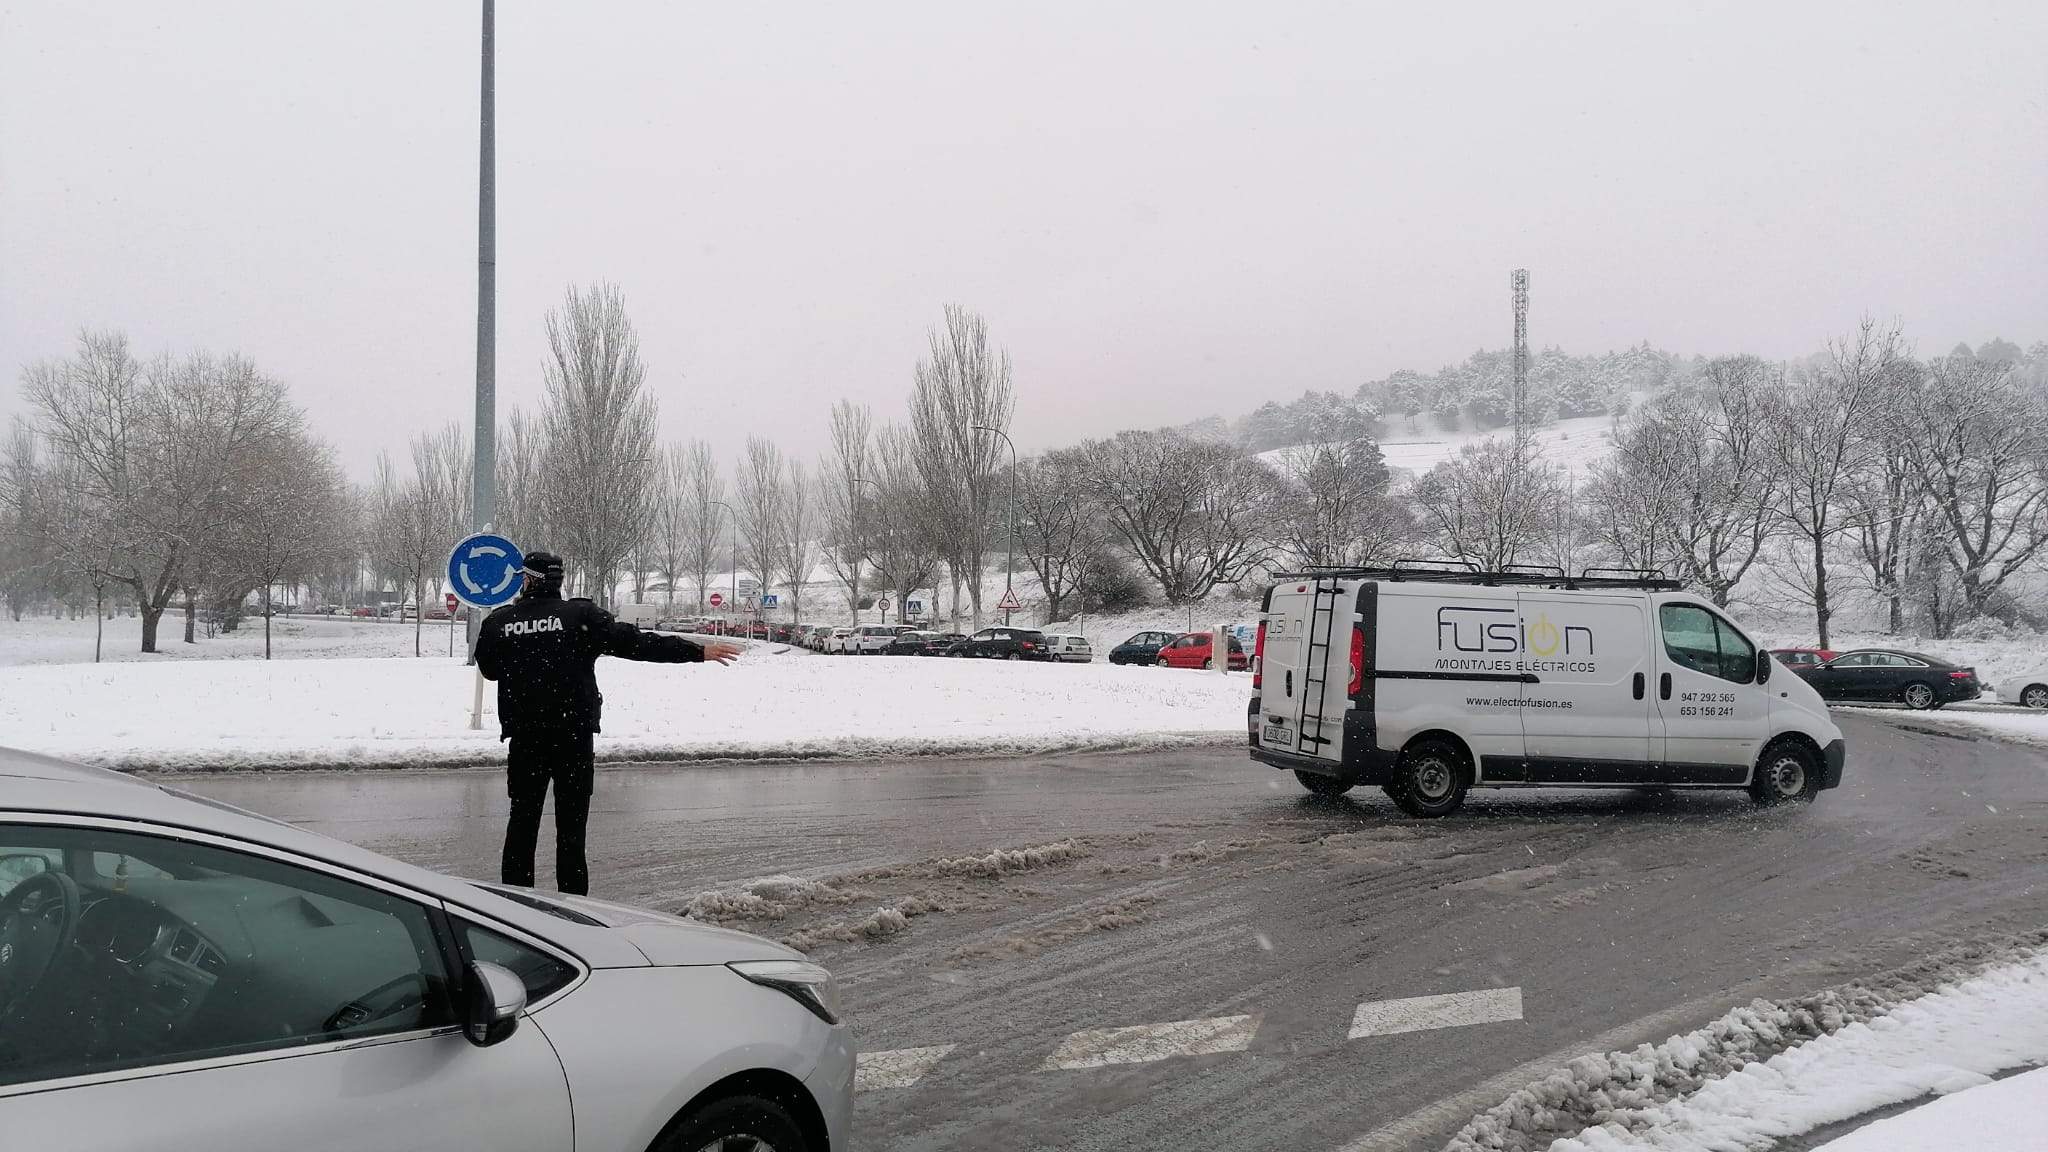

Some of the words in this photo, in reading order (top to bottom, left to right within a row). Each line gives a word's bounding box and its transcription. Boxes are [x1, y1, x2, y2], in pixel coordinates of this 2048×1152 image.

[504, 615, 564, 637] POLICÍA
[1435, 658, 1512, 671] MONTAJES
[1516, 659, 1596, 672] ELÉCTRICOS
[1466, 697, 1573, 709] www.electrofusion.es
[1681, 692, 1698, 702] 947
[1700, 693, 1717, 702] 292
[1719, 693, 1735, 703] 565
[1680, 706, 1697, 716] 653
[1700, 706, 1716, 716] 156
[1718, 706, 1734, 716] 241
